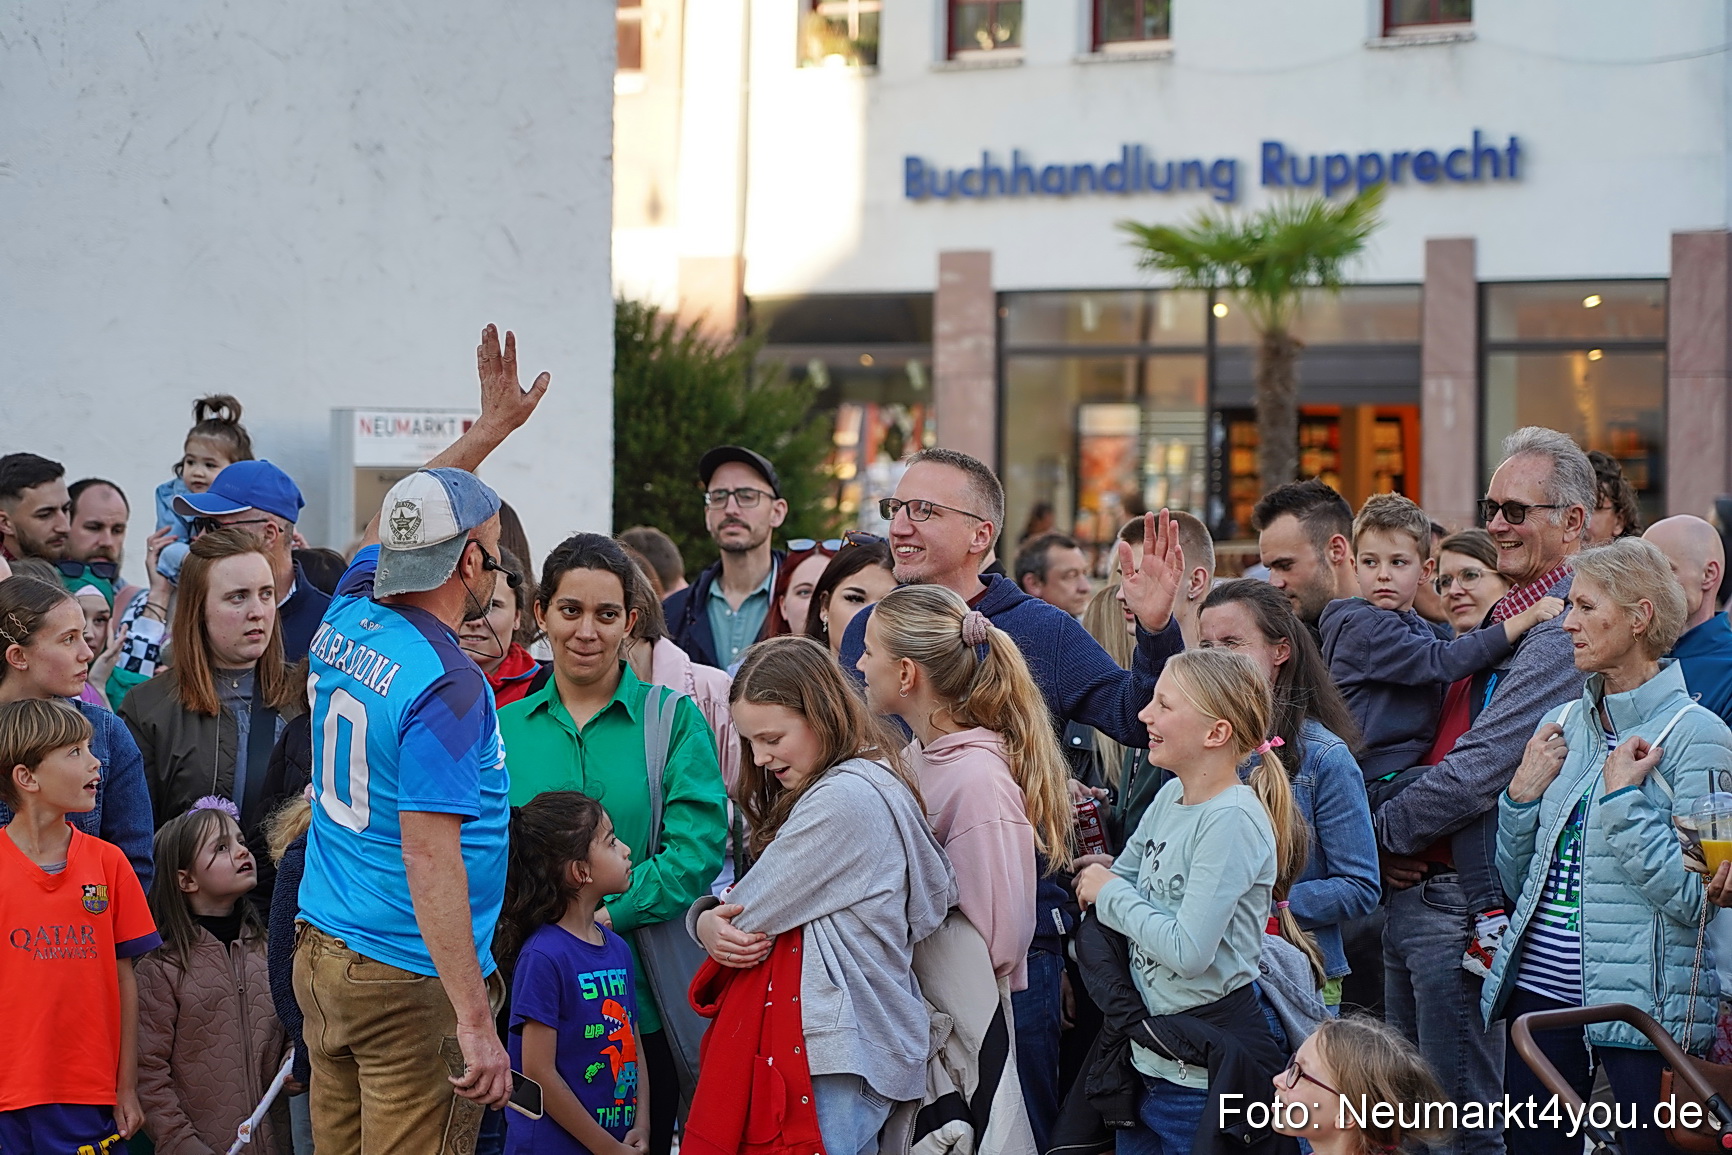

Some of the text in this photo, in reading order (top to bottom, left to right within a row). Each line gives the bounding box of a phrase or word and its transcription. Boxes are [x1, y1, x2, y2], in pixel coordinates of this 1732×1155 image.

[904, 129, 1524, 202] Buchhandlung Rupprecht
[359, 415, 456, 438] NEUMARKT
[9, 925, 96, 952] QATAR
[32, 946, 98, 960] AIRWAYS
[584, 1023, 605, 1038] UP
[596, 1106, 621, 1128] THE
